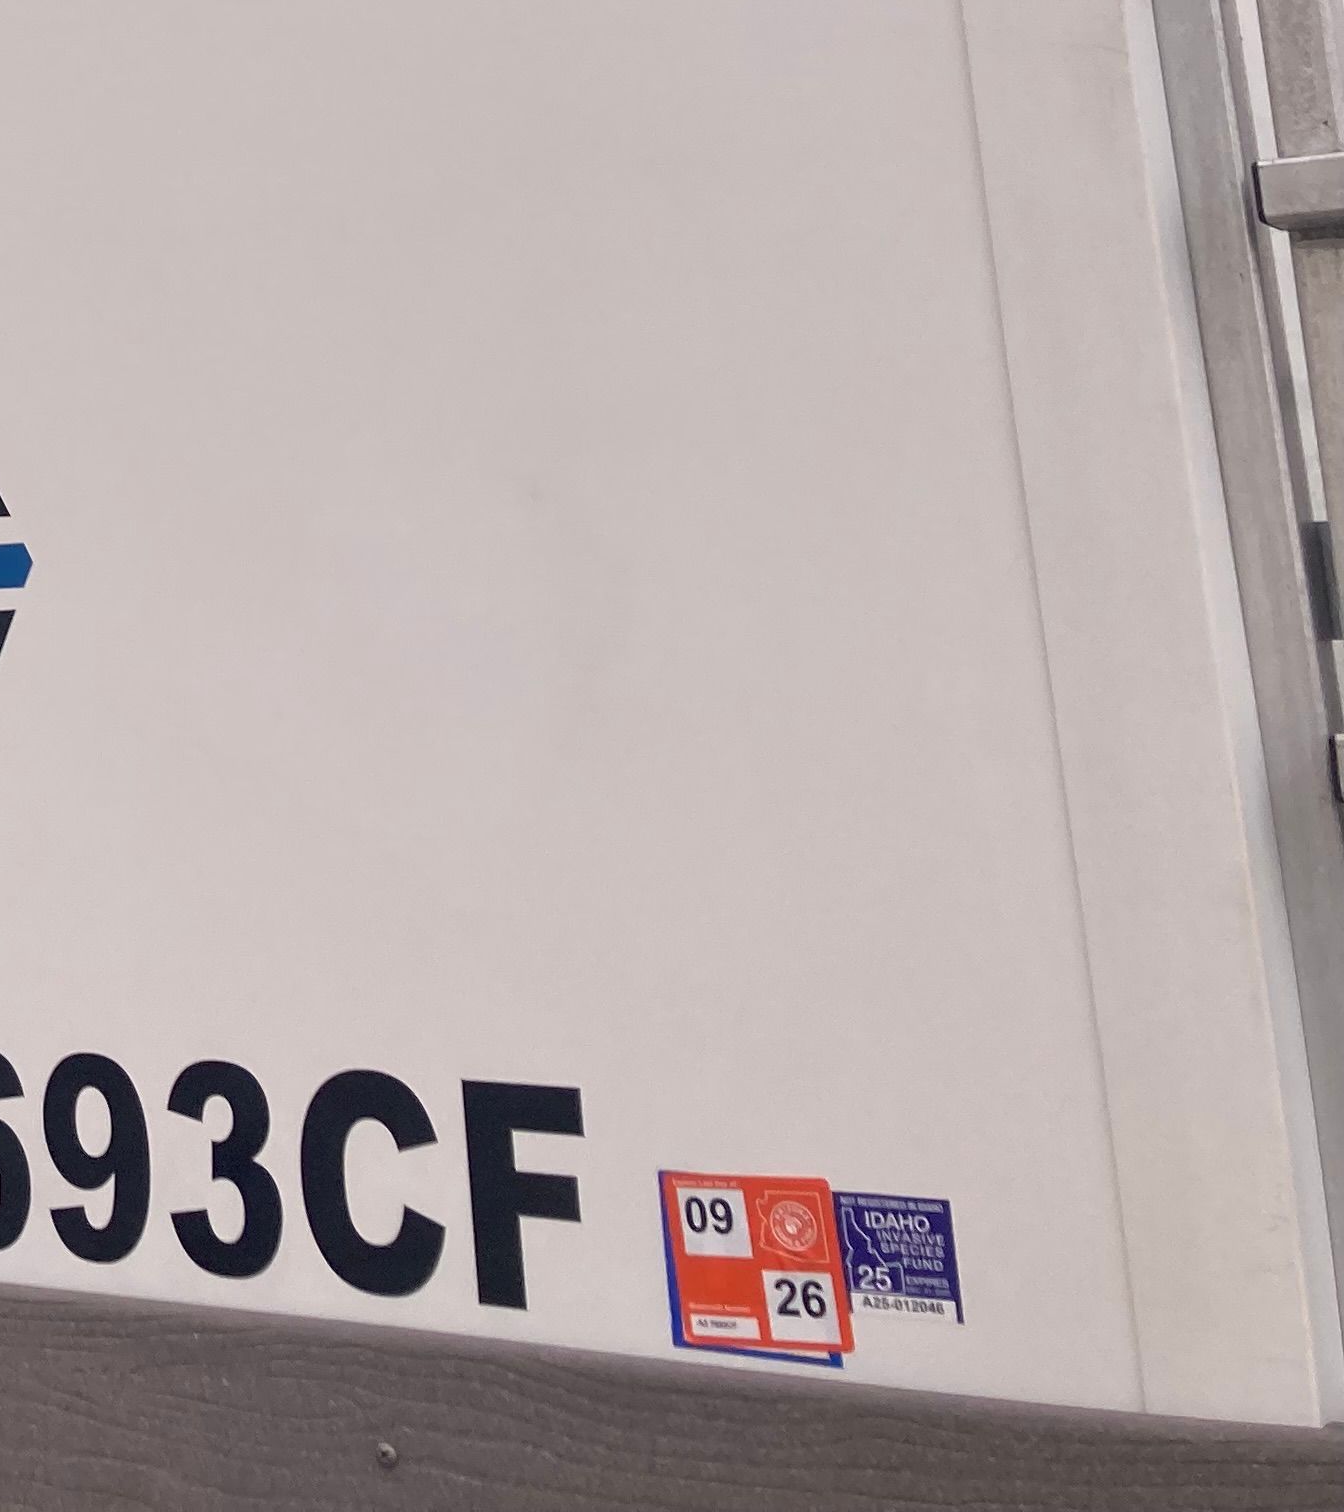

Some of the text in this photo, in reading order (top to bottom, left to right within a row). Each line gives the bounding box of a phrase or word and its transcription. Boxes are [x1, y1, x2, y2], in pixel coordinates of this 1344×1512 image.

[685, 1197, 734, 1235] 09
[864, 1210, 931, 1233] IDAHO
[876, 1229, 945, 1247] INVASIVE
[879, 1243, 945, 1258] SPECIES
[902, 1257, 944, 1272] FUND
[858, 1264, 893, 1291] 25
[774, 1278, 827, 1319] 26
